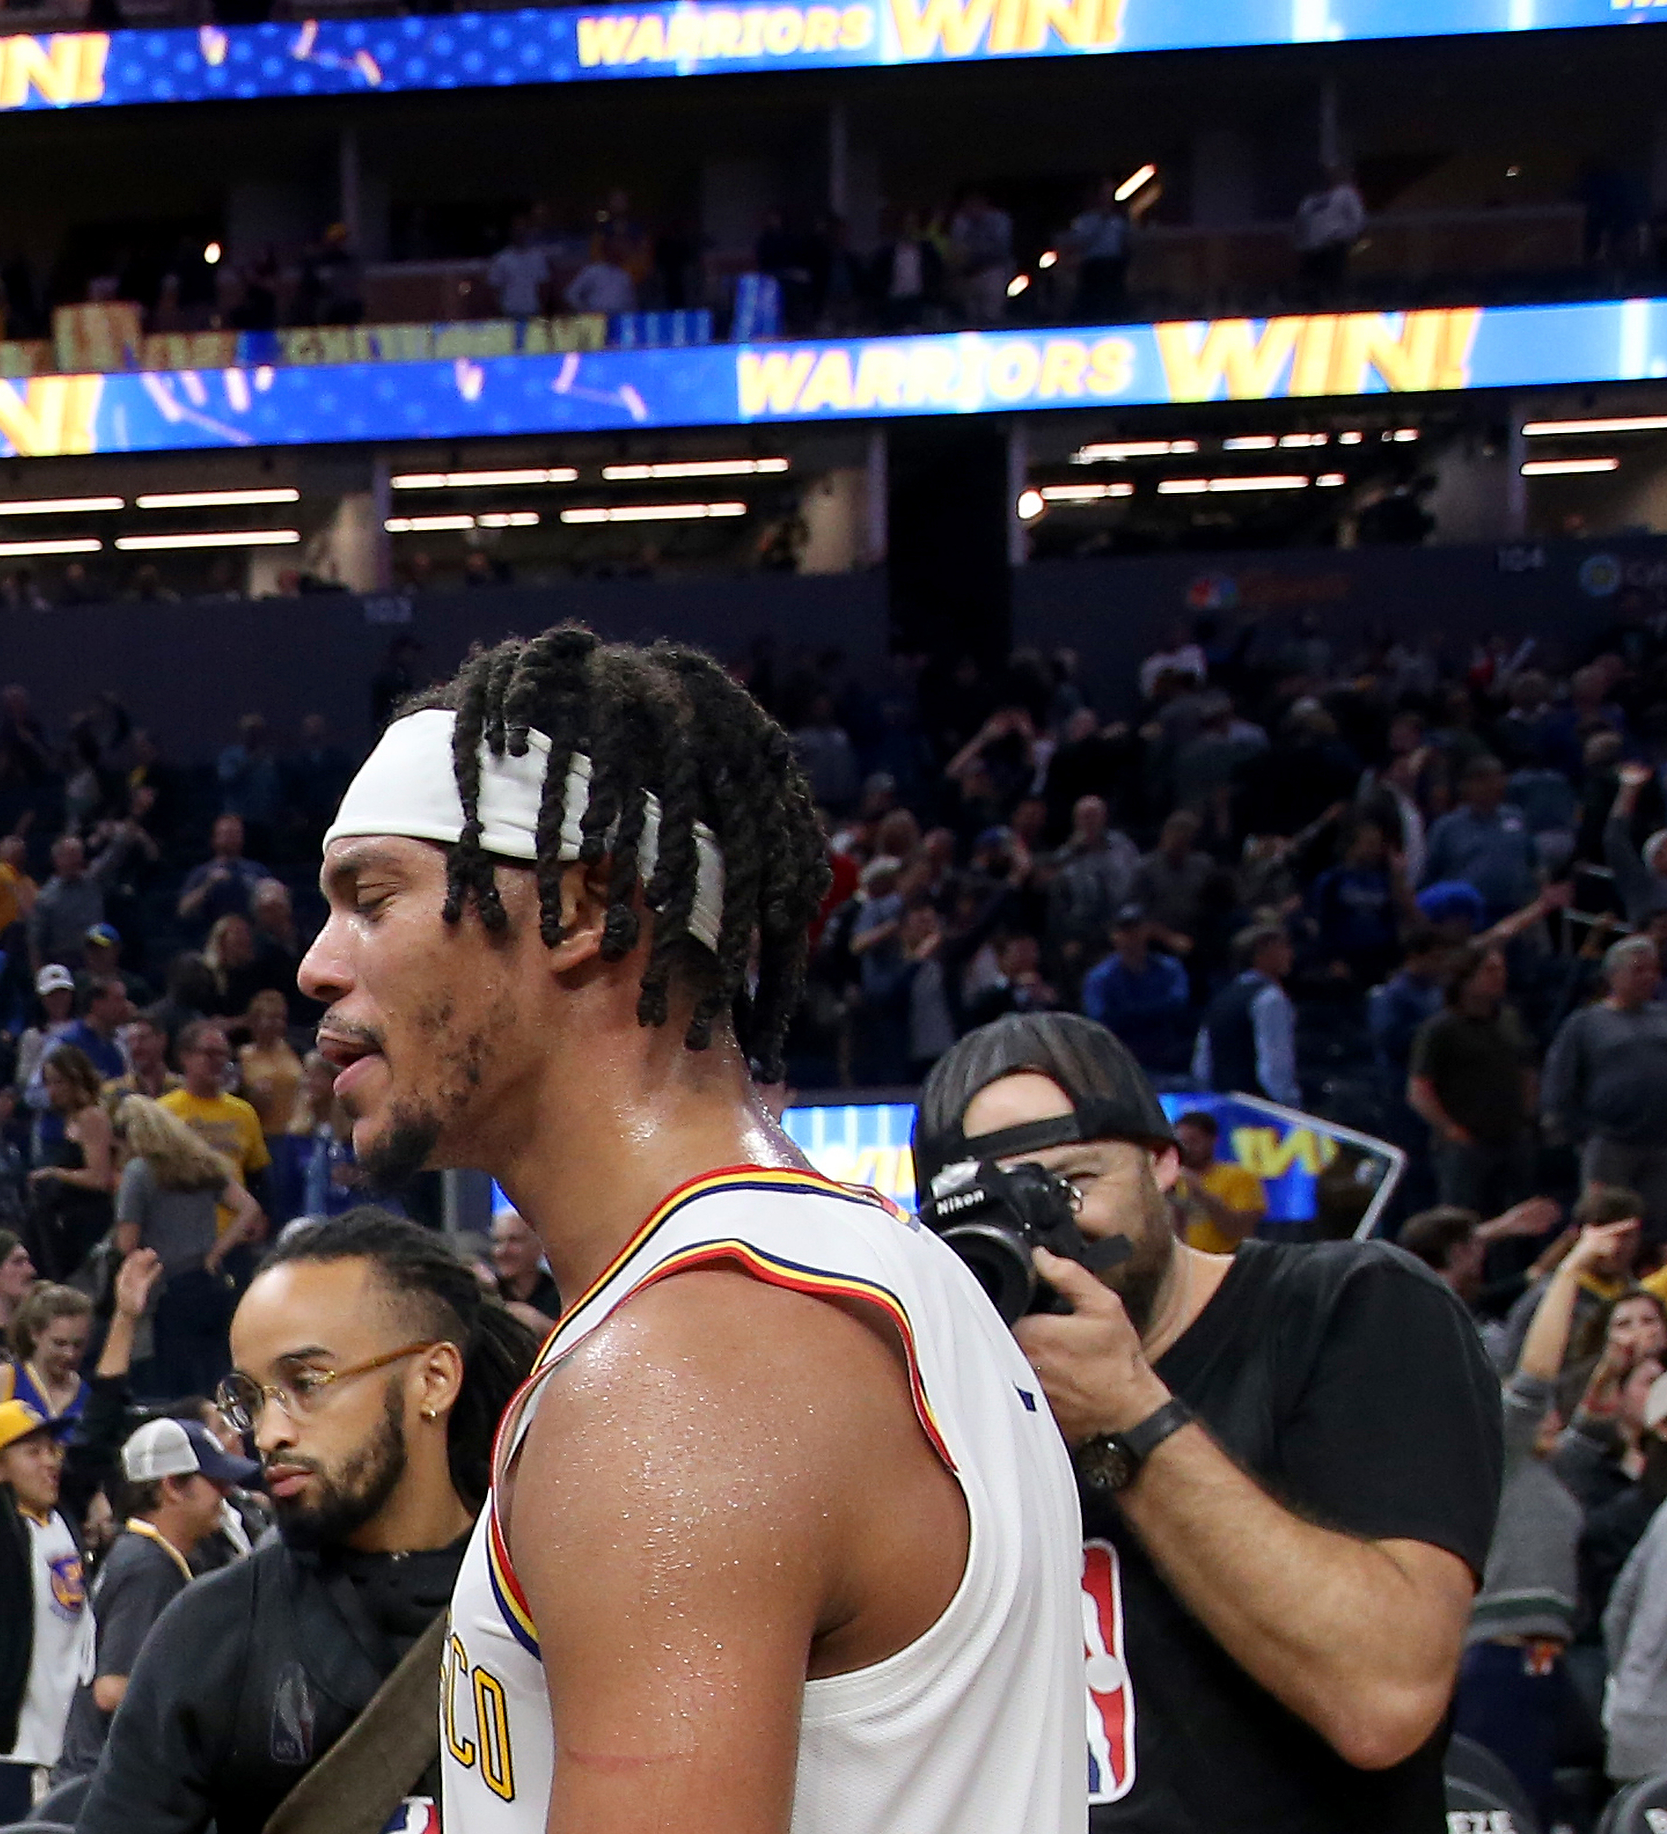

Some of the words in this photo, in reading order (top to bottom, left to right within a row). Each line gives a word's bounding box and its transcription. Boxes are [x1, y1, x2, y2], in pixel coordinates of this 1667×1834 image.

[576, 7, 868, 67] WARRIORS
[882, 0, 1128, 57] WIN!
[738, 339, 1136, 415] WARRIORS
[1154, 306, 1482, 404] WIN!
[936, 1189, 985, 1216] Nikon
[445, 1631, 516, 1802] CO
